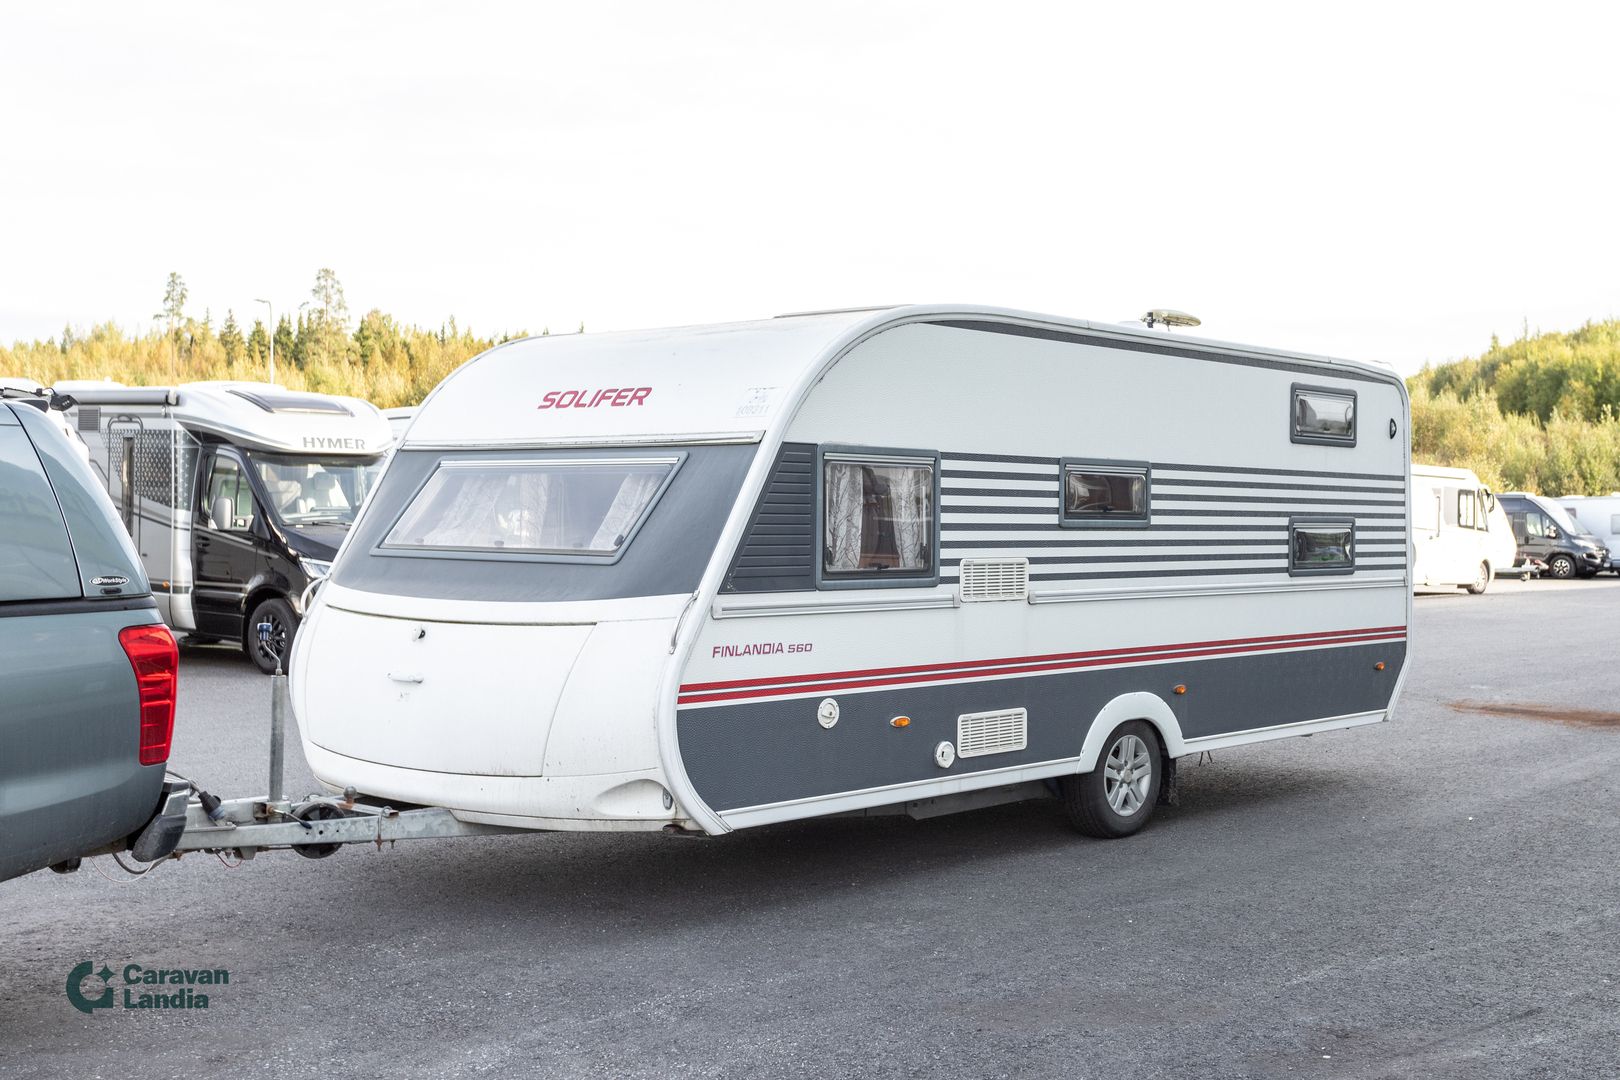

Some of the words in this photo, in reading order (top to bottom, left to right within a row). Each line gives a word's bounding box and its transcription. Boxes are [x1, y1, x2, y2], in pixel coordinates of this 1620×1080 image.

[537, 387, 652, 409] SOLIFER
[303, 437, 366, 449] HYMER
[712, 643, 784, 658] FINLANDIA
[787, 643, 813, 653] 560
